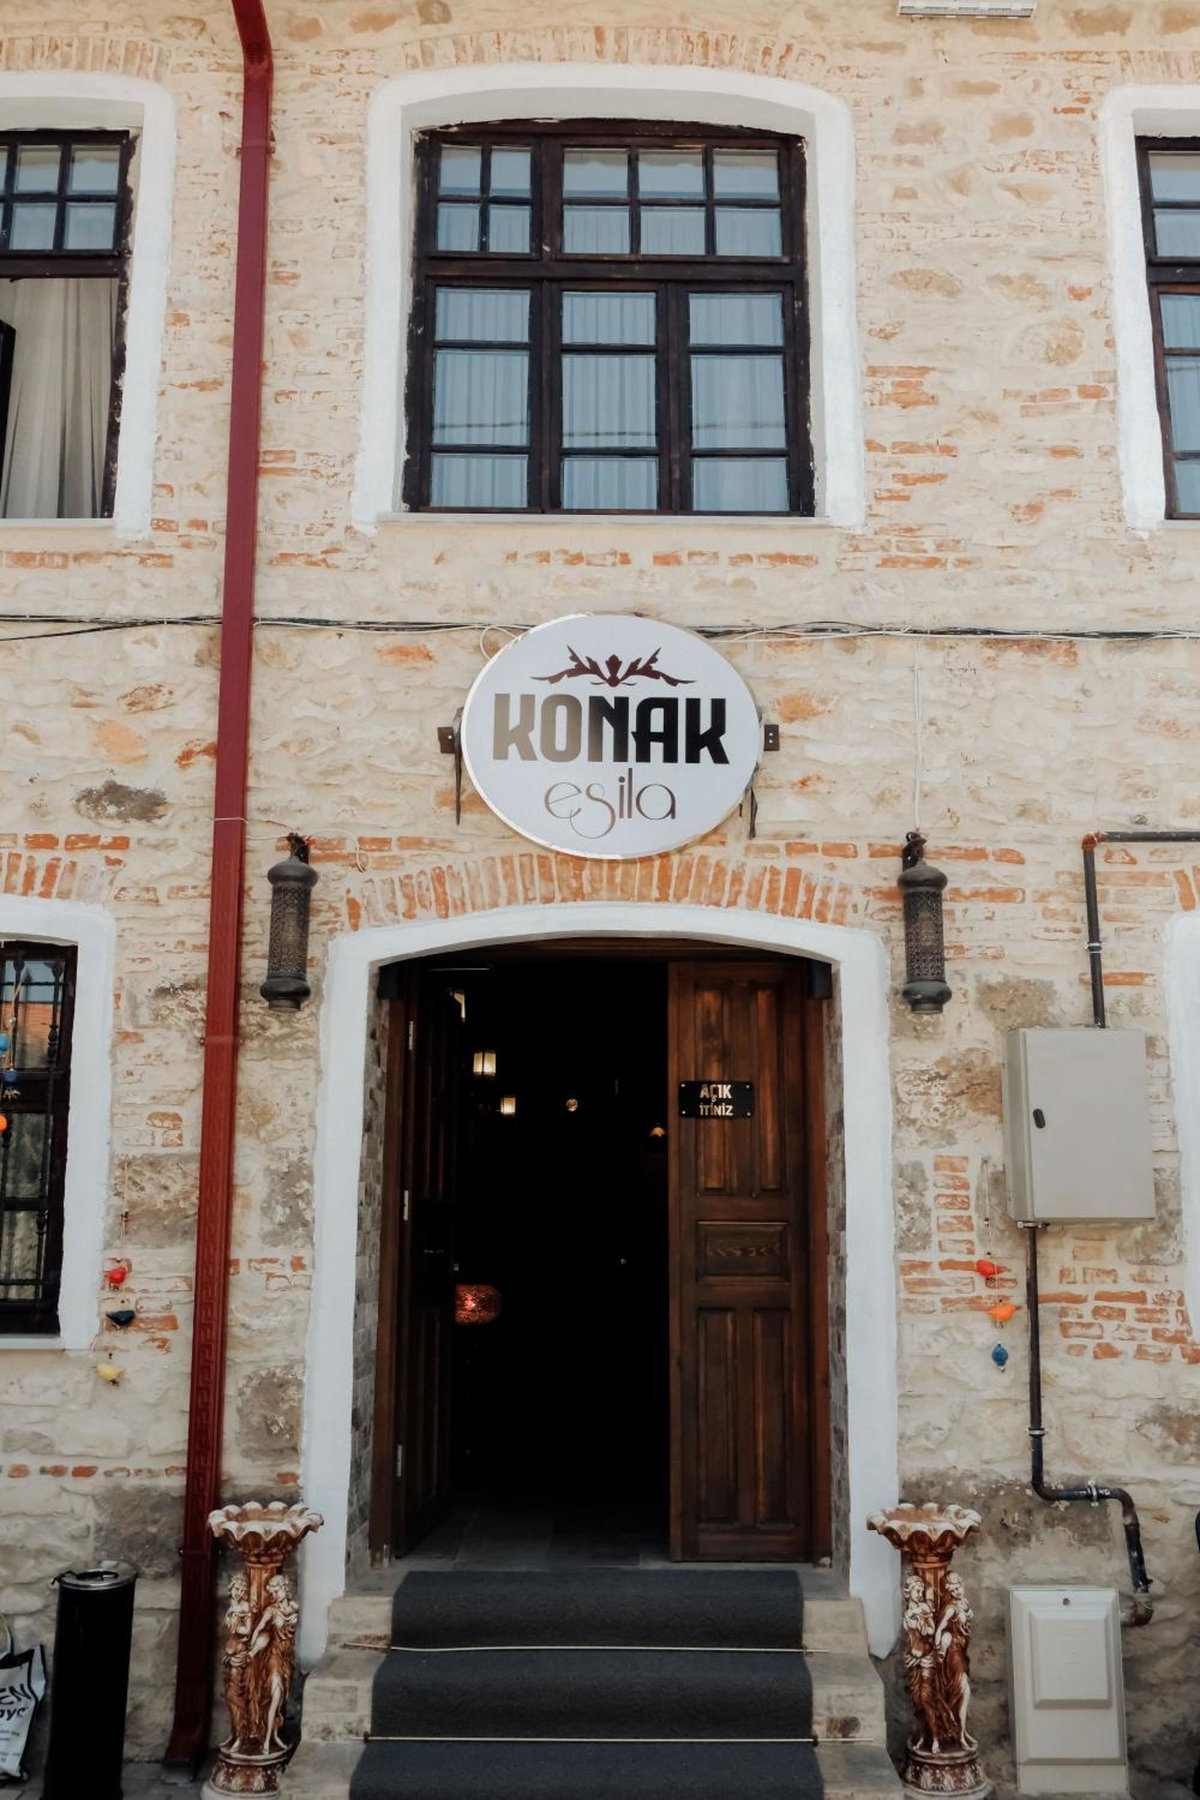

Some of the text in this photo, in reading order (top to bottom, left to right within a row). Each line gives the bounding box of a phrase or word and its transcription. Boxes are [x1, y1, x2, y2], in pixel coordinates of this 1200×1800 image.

[492, 692, 730, 764] KONAK
[543, 767, 676, 839] esila
[699, 1084, 732, 1102] AÇIK
